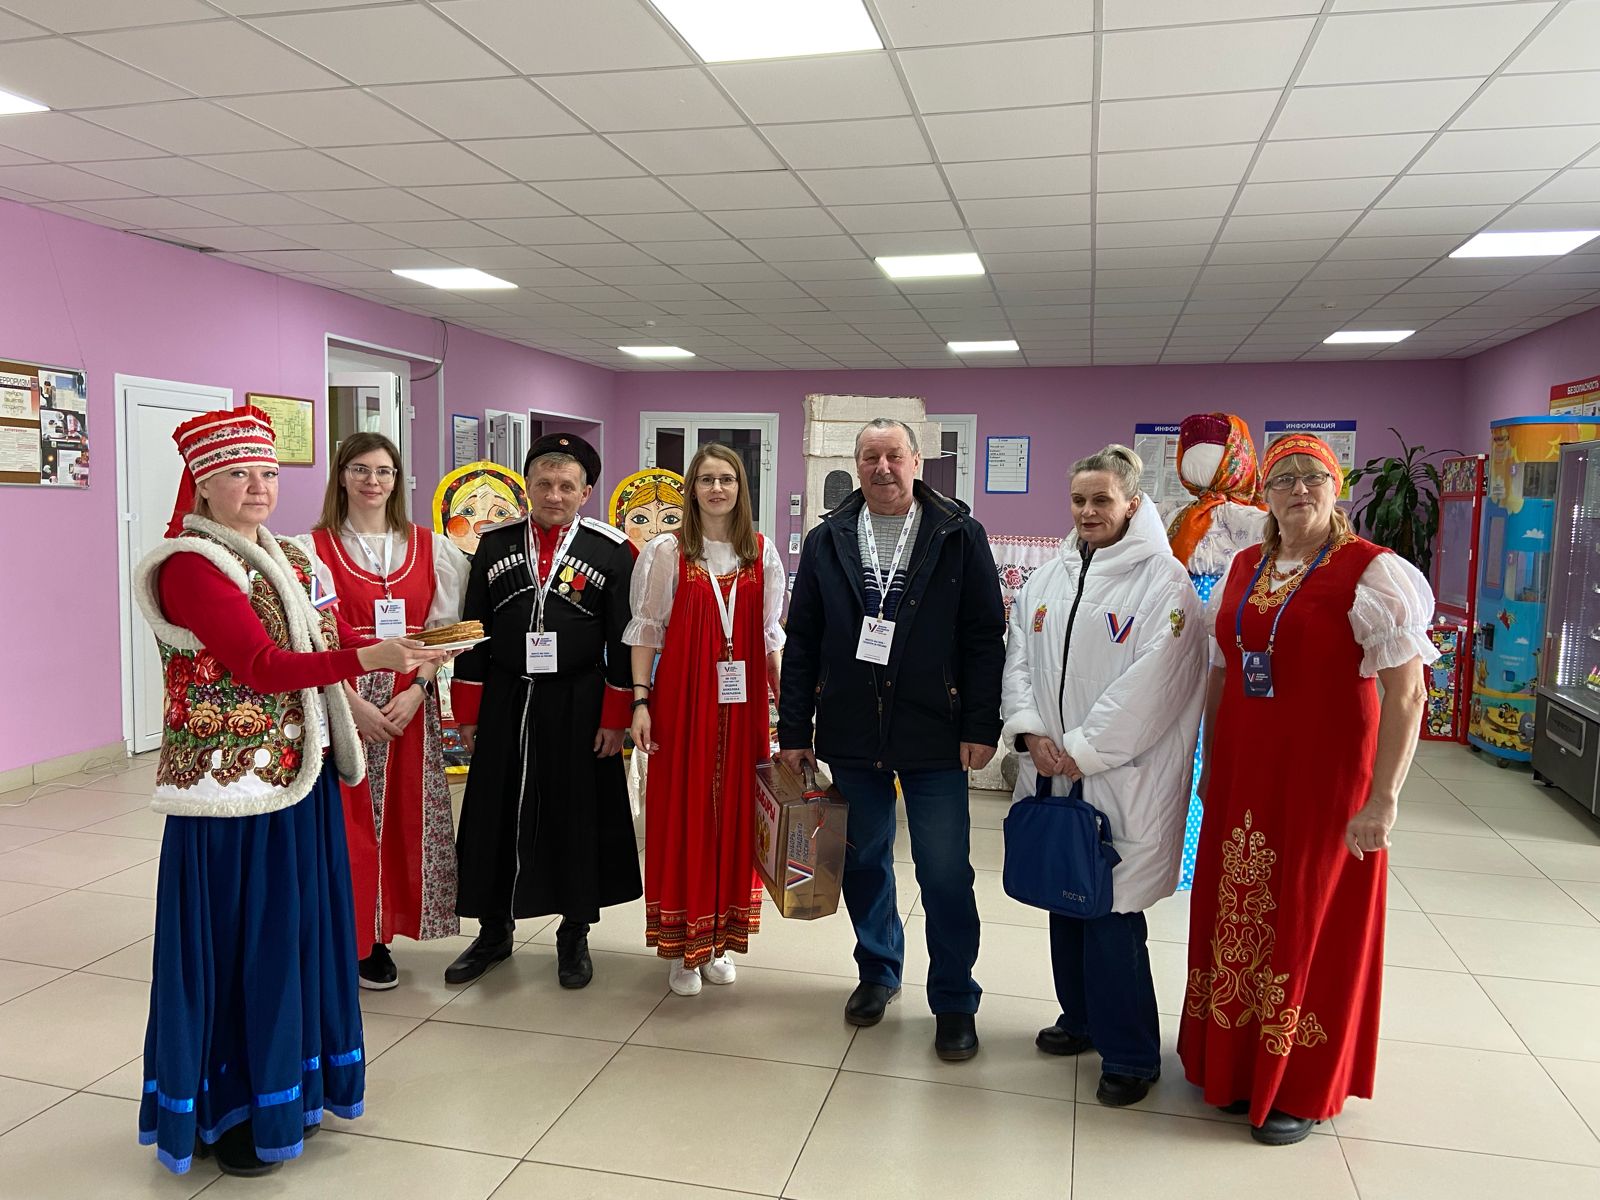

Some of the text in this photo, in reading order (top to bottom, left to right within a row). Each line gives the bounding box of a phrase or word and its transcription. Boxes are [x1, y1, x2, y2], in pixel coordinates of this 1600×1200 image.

[0, 375, 30, 387] ЕРРОРИЗМ
[1285, 422, 1336, 430] ИНФОРМАЦИЯ
[755, 783, 776, 823] ЫБОРЫ
